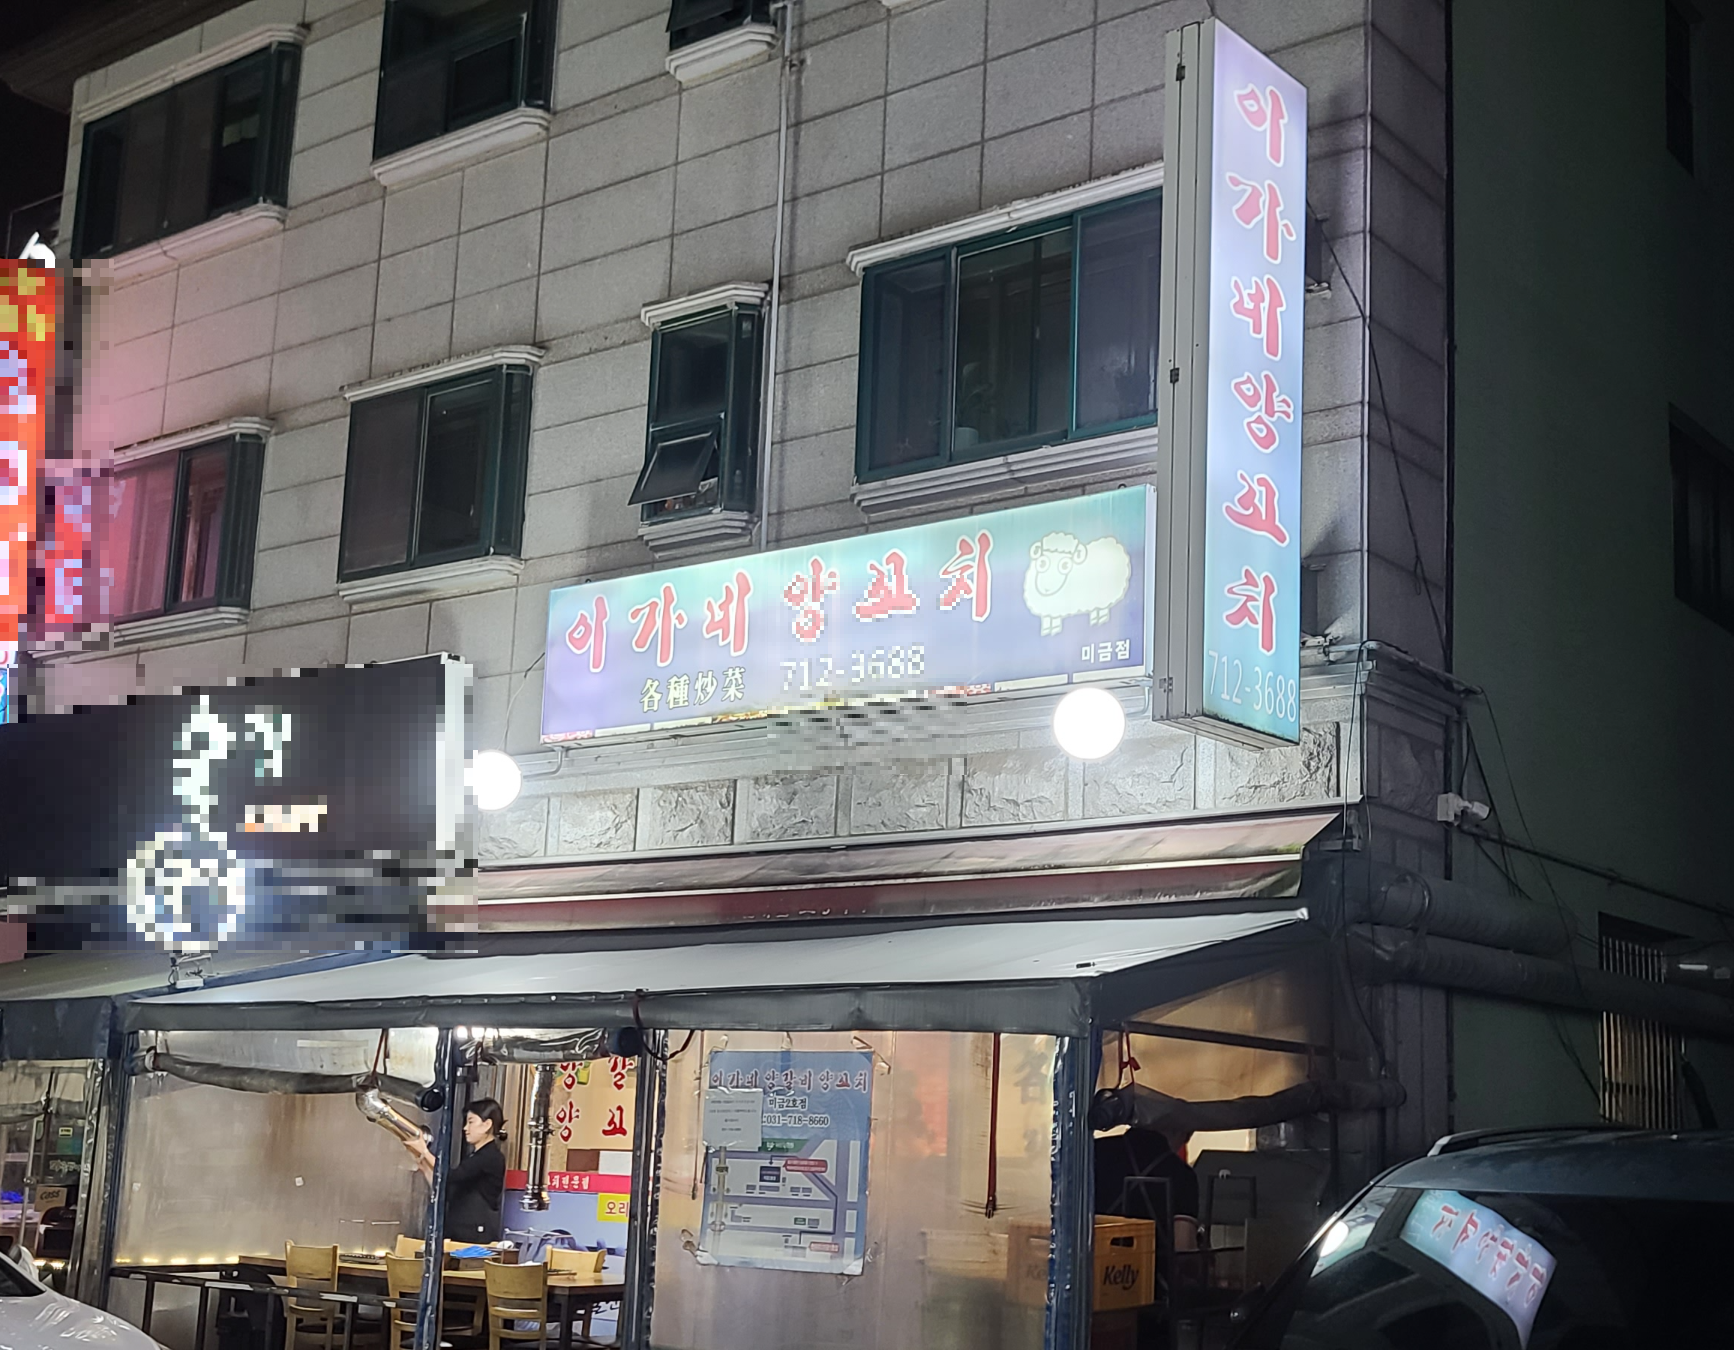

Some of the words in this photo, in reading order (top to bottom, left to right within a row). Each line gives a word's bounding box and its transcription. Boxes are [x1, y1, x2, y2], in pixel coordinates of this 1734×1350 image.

[1081, 639, 1131, 664] 미금점
[640, 666, 746, 713] 各種炒菜
[1208, 650, 1297, 722] 712-3688
[768, 1096, 808, 1111] 미금2호점
[1102, 1264, 1140, 1291] Kelly
